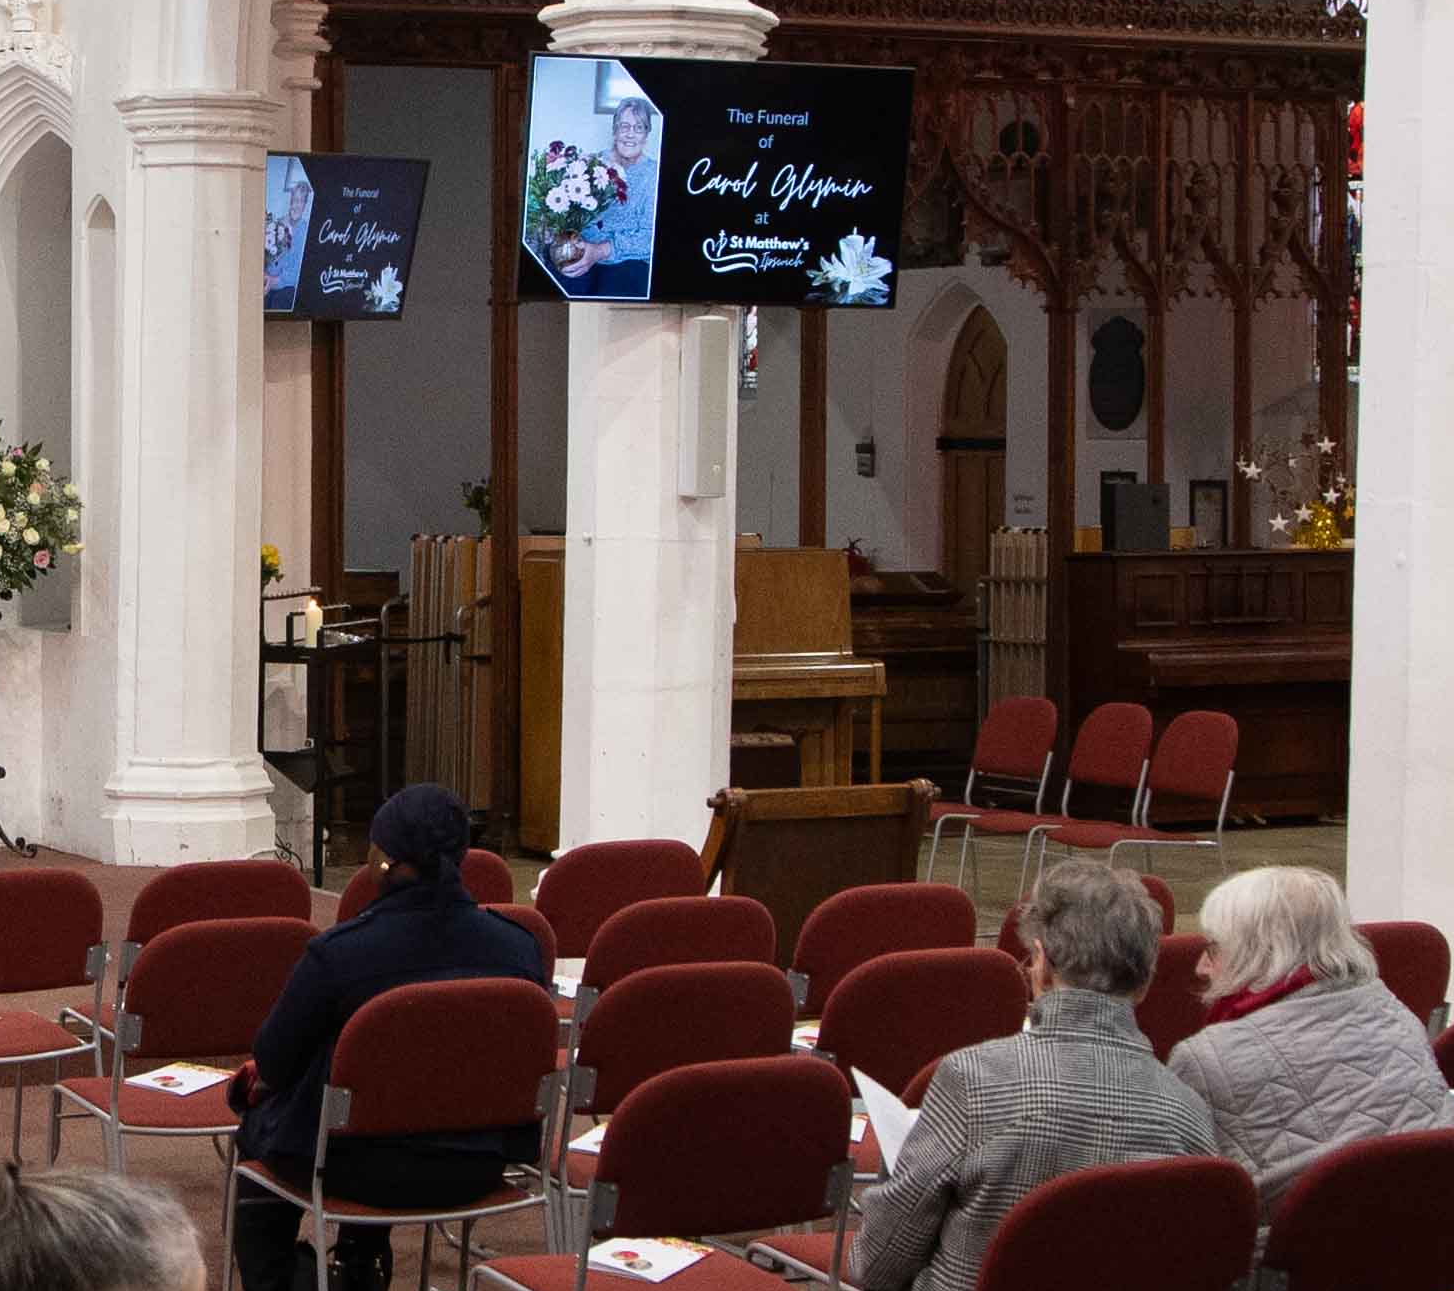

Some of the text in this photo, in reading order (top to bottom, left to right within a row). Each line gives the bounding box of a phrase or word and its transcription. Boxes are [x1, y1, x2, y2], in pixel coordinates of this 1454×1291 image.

[726, 108, 810, 127] The Funeral
[758, 134, 775, 149] of
[687, 157, 759, 198] Carol
[754, 211, 770, 225] at
[319, 219, 353, 246] Carol
[729, 236, 810, 251] St Matthew's
